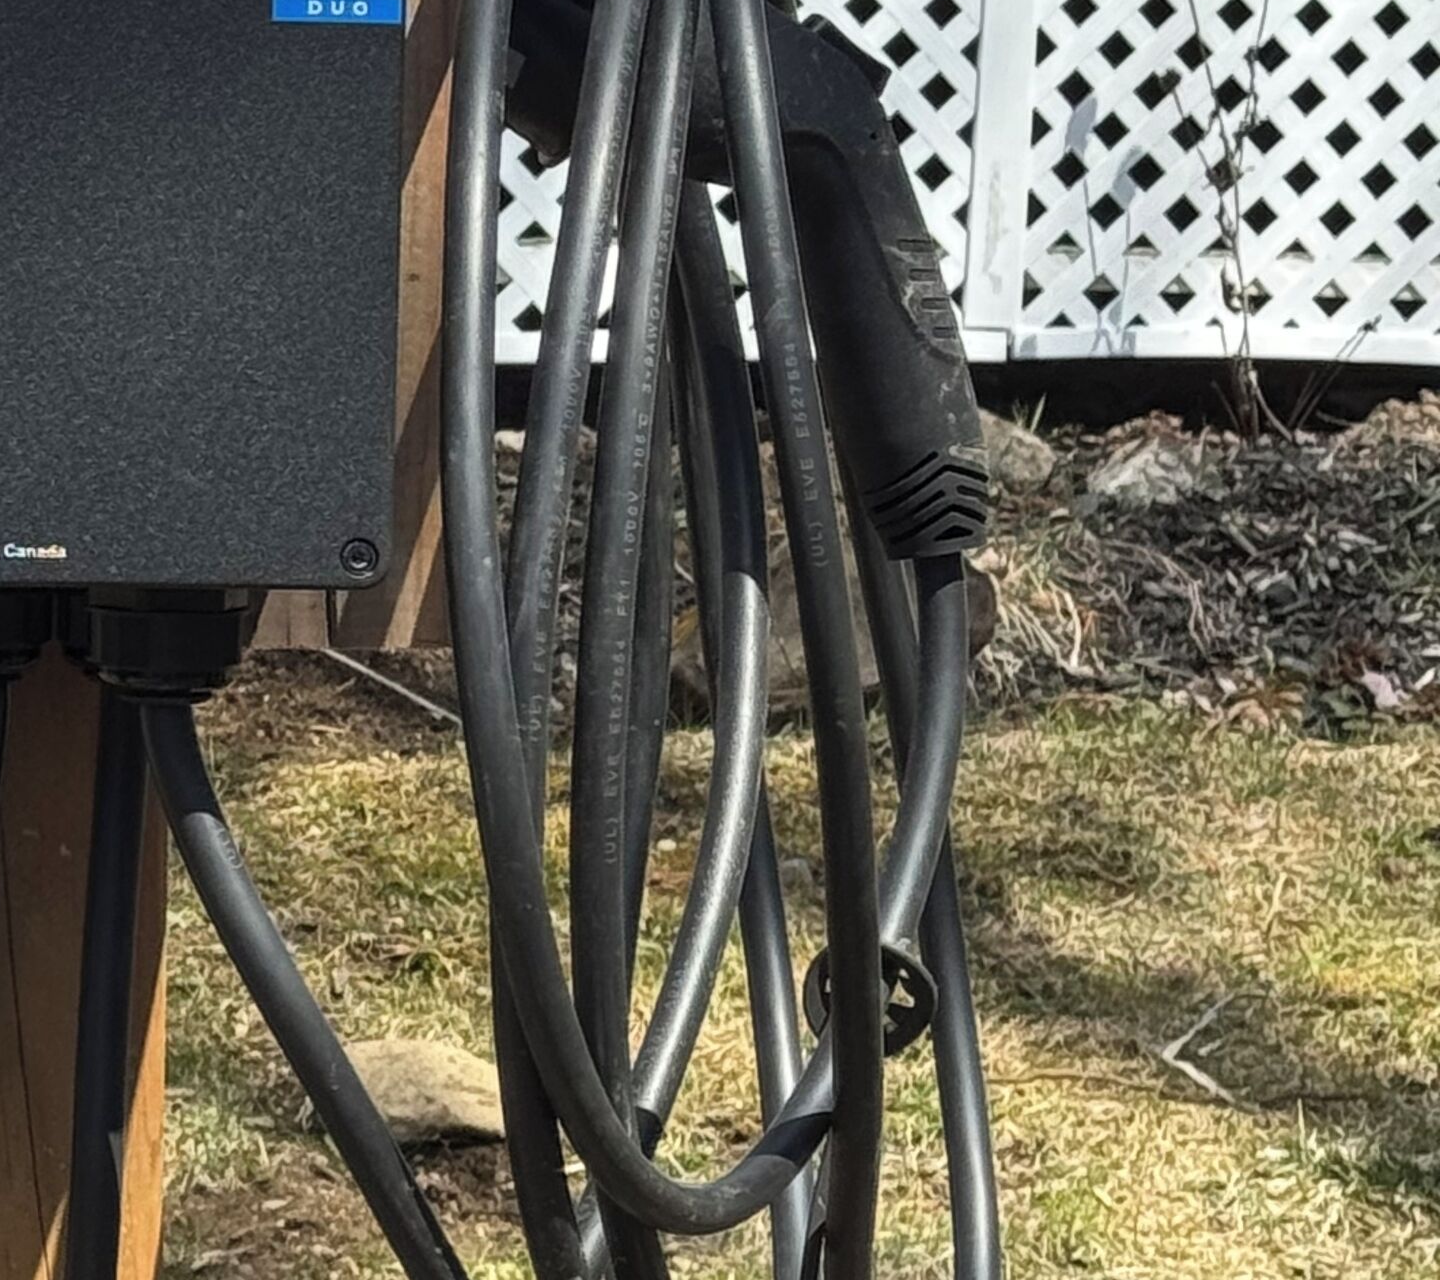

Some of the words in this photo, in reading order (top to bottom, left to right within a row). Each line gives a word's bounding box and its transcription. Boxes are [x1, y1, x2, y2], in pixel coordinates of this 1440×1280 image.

[307, 0, 369, 17] DUO
[799, 457, 818, 502] EVE
[622, 490, 639, 556] 1000V
[808, 521, 829, 568] (UL)
[4, 543, 67, 559] Canada
[532, 631, 547, 674] EVE
[602, 754, 620, 797] EVE
[602, 816, 619, 864] (UL)
